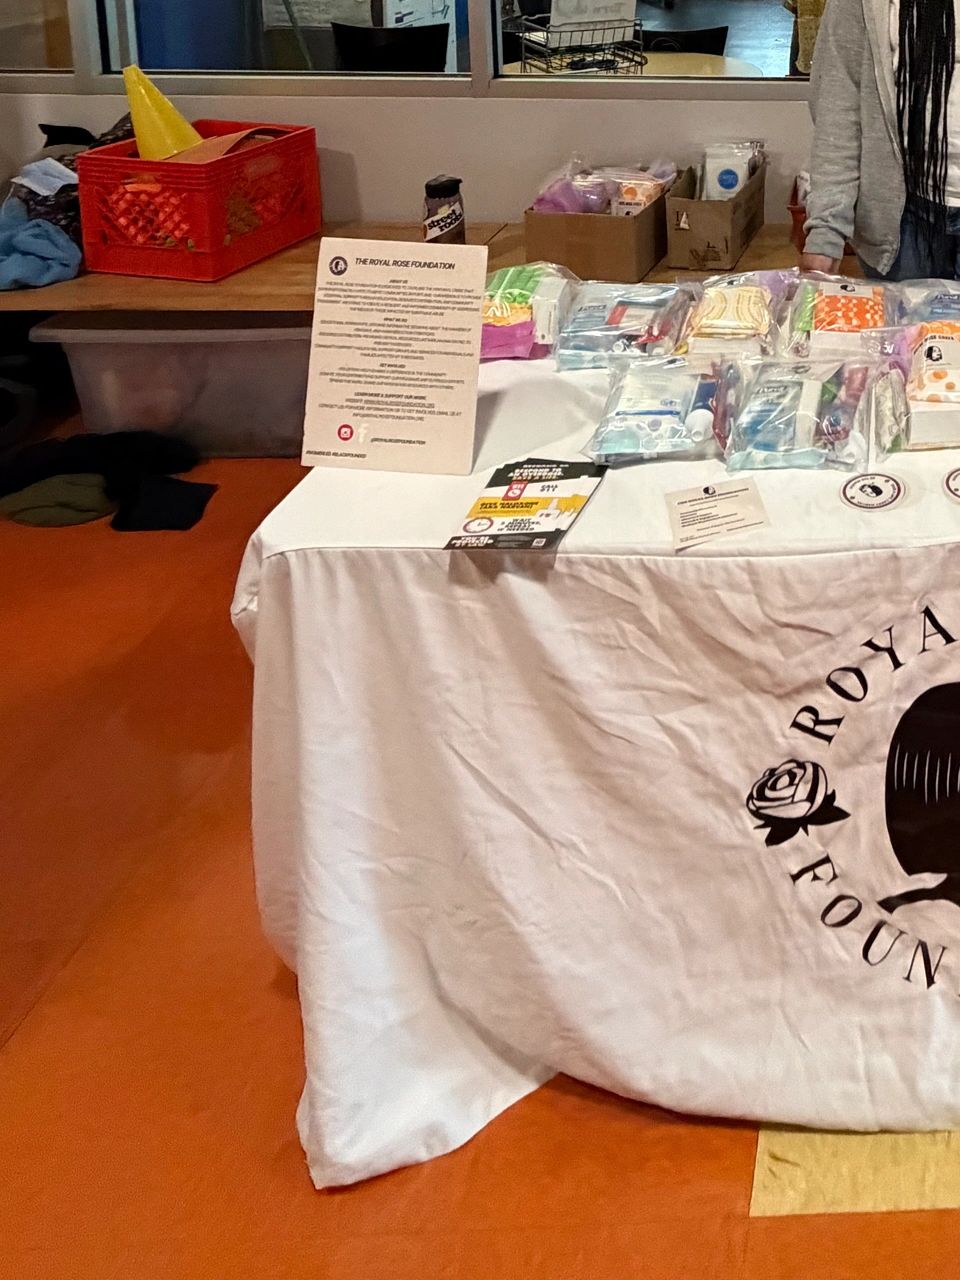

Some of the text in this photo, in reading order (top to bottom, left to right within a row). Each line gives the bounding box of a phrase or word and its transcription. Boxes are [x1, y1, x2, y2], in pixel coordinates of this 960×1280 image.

[427, 209, 457, 231] street
[355, 257, 456, 270] THE ROYAL ROSE FOUNDATION
